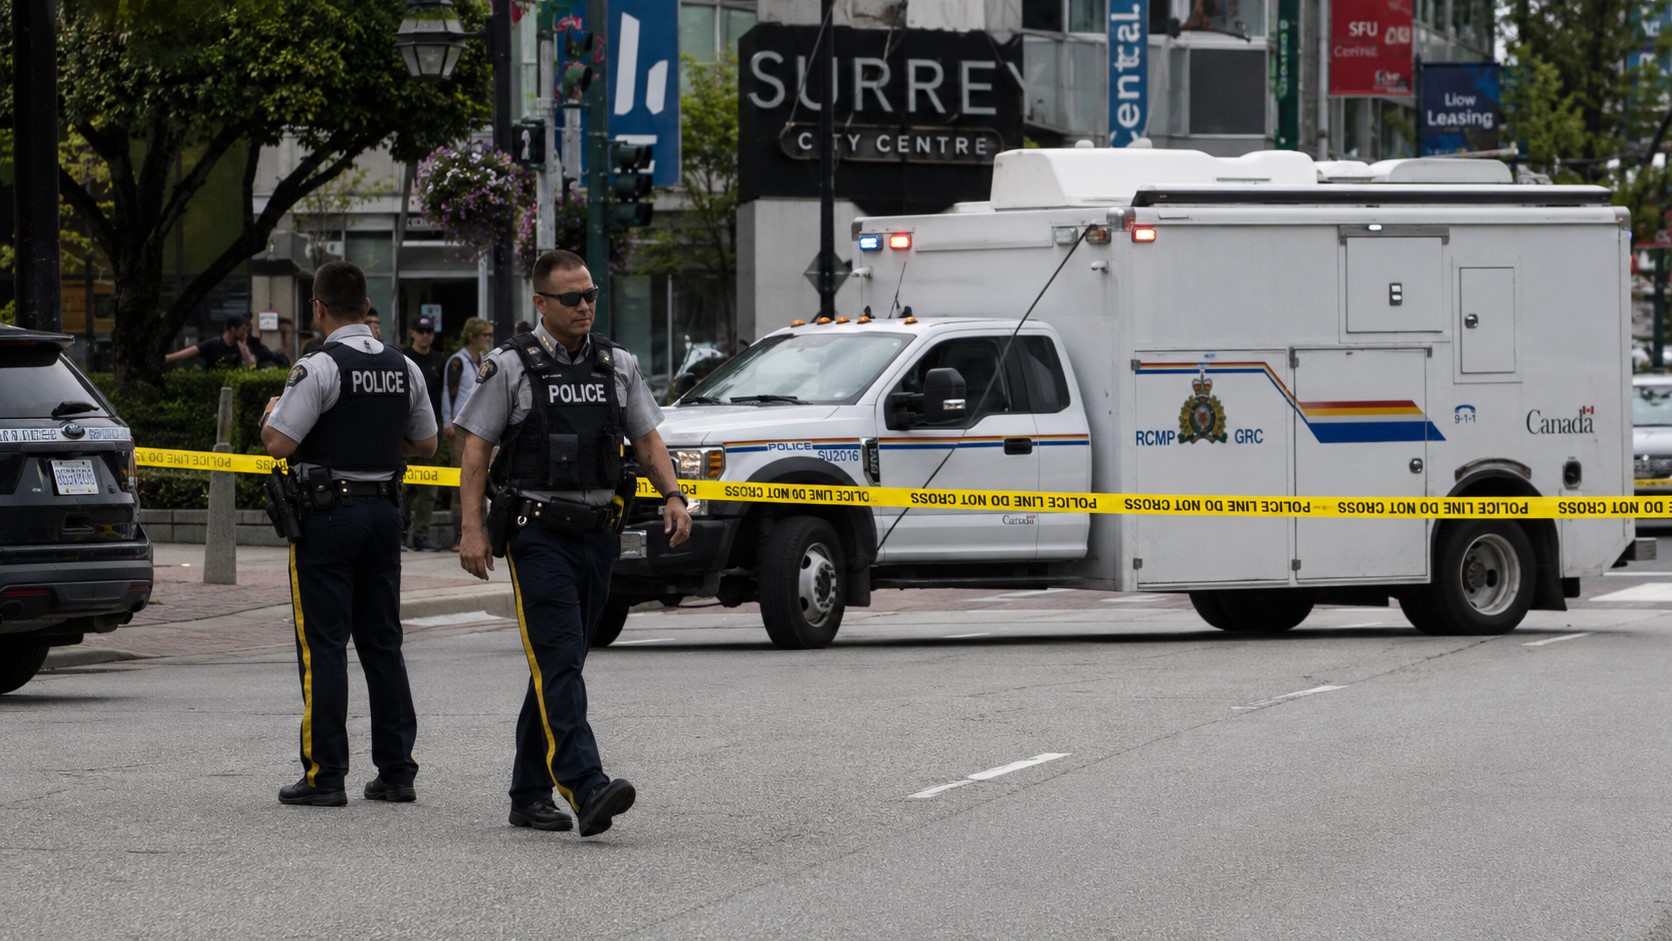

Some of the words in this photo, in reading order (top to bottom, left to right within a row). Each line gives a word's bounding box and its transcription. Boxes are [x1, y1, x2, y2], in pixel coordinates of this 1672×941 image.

[1349, 21, 1378, 37] SFU
[748, 50, 1041, 116] SURREY
[1427, 110, 1493, 129] Leasing
[798, 132, 861, 151] CTY
[876, 134, 988, 155] CENTRE
[352, 370, 405, 393] POLICE
[549, 383, 607, 404] POLICE
[1526, 409, 1594, 435] Canada
[1135, 430, 1176, 446] RCMP
[1235, 429, 1264, 444] GRC
[818, 450, 859, 461] SU2016
[725, 486, 763, 498] CROSS
[767, 488, 790, 499] NOT
[792, 489, 806, 500] DO
[809, 489, 833, 501] LINE
[910, 493, 956, 504] CROSS
[961, 494, 986, 506] NOT
[991, 495, 1010, 506] DO
[1014, 496, 1044, 507] LINE
[1048, 497, 1097, 509] POLICE
[1124, 498, 1170, 511] CROSS
[1174, 499, 1200, 511] NOT
[1205, 500, 1223, 511] DO
[1228, 501, 1257, 512] LINE
[1261, 501, 1310, 513] POLICE
[1338, 501, 1384, 514] CROSS
[1389, 502, 1416, 514] NOT
[1420, 502, 1438, 514] DO
[1444, 502, 1474, 514] LINE
[1478, 502, 1529, 514] POLICE
[1558, 502, 1606, 514] CROSS
[1611, 501, 1639, 514] NOT
[1644, 501, 1663, 513] DO
